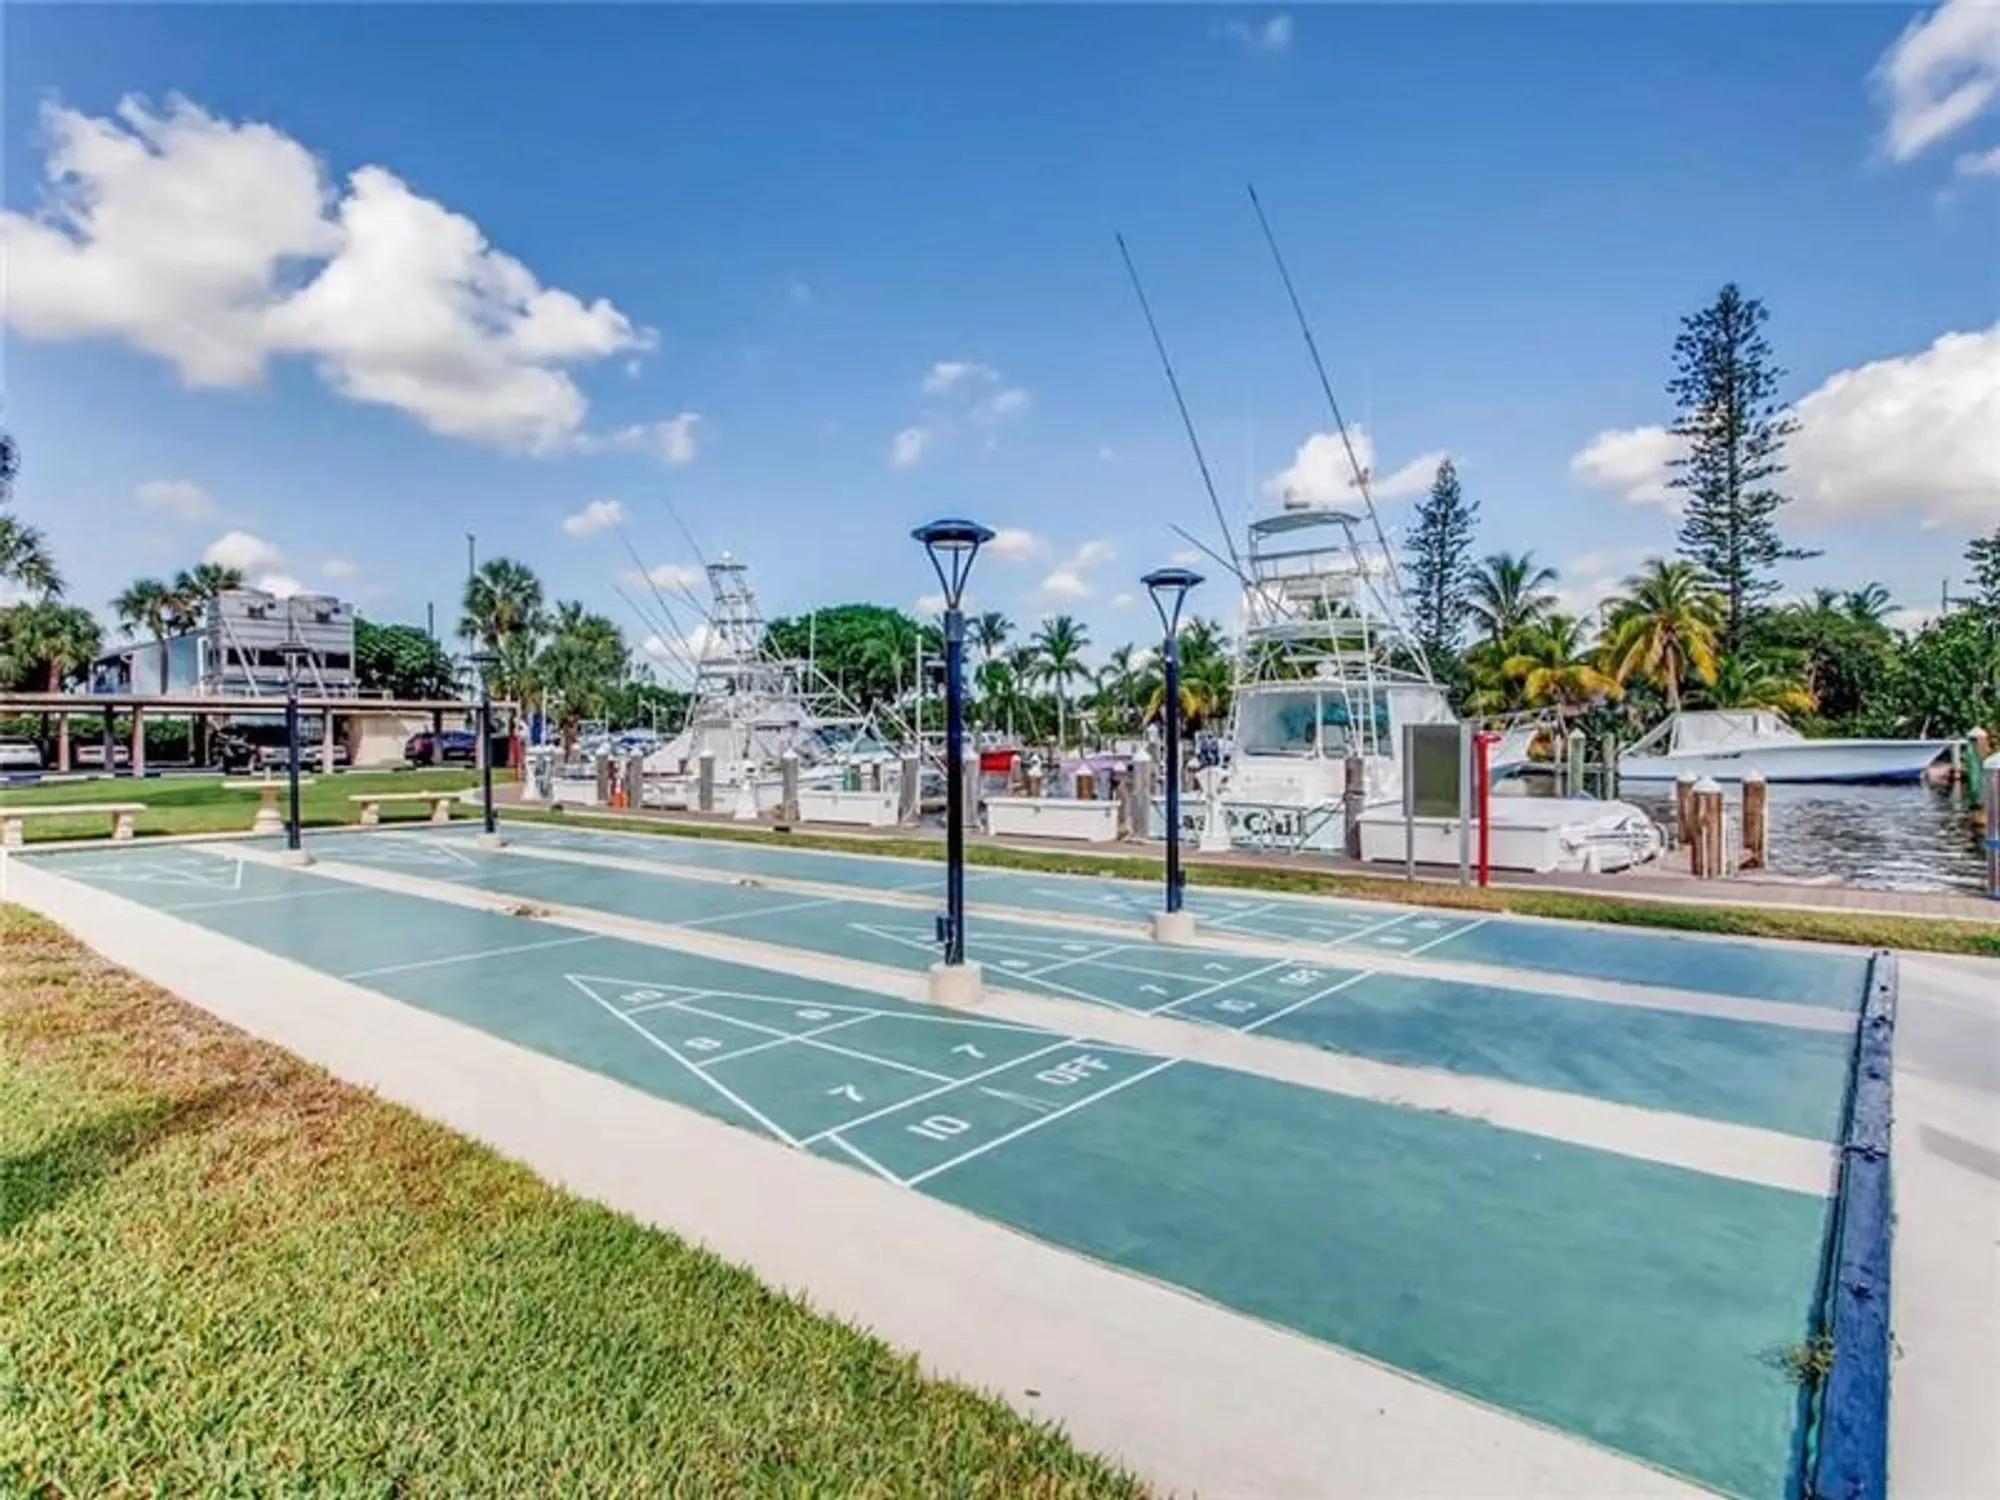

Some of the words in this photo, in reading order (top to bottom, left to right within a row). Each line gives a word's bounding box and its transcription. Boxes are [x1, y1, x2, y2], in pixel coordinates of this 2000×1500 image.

[950, 1043, 986, 1059] 7
[827, 1083, 865, 1102] 7
[905, 1114, 972, 1141] 10
[1034, 1054, 1110, 1085] OFF
